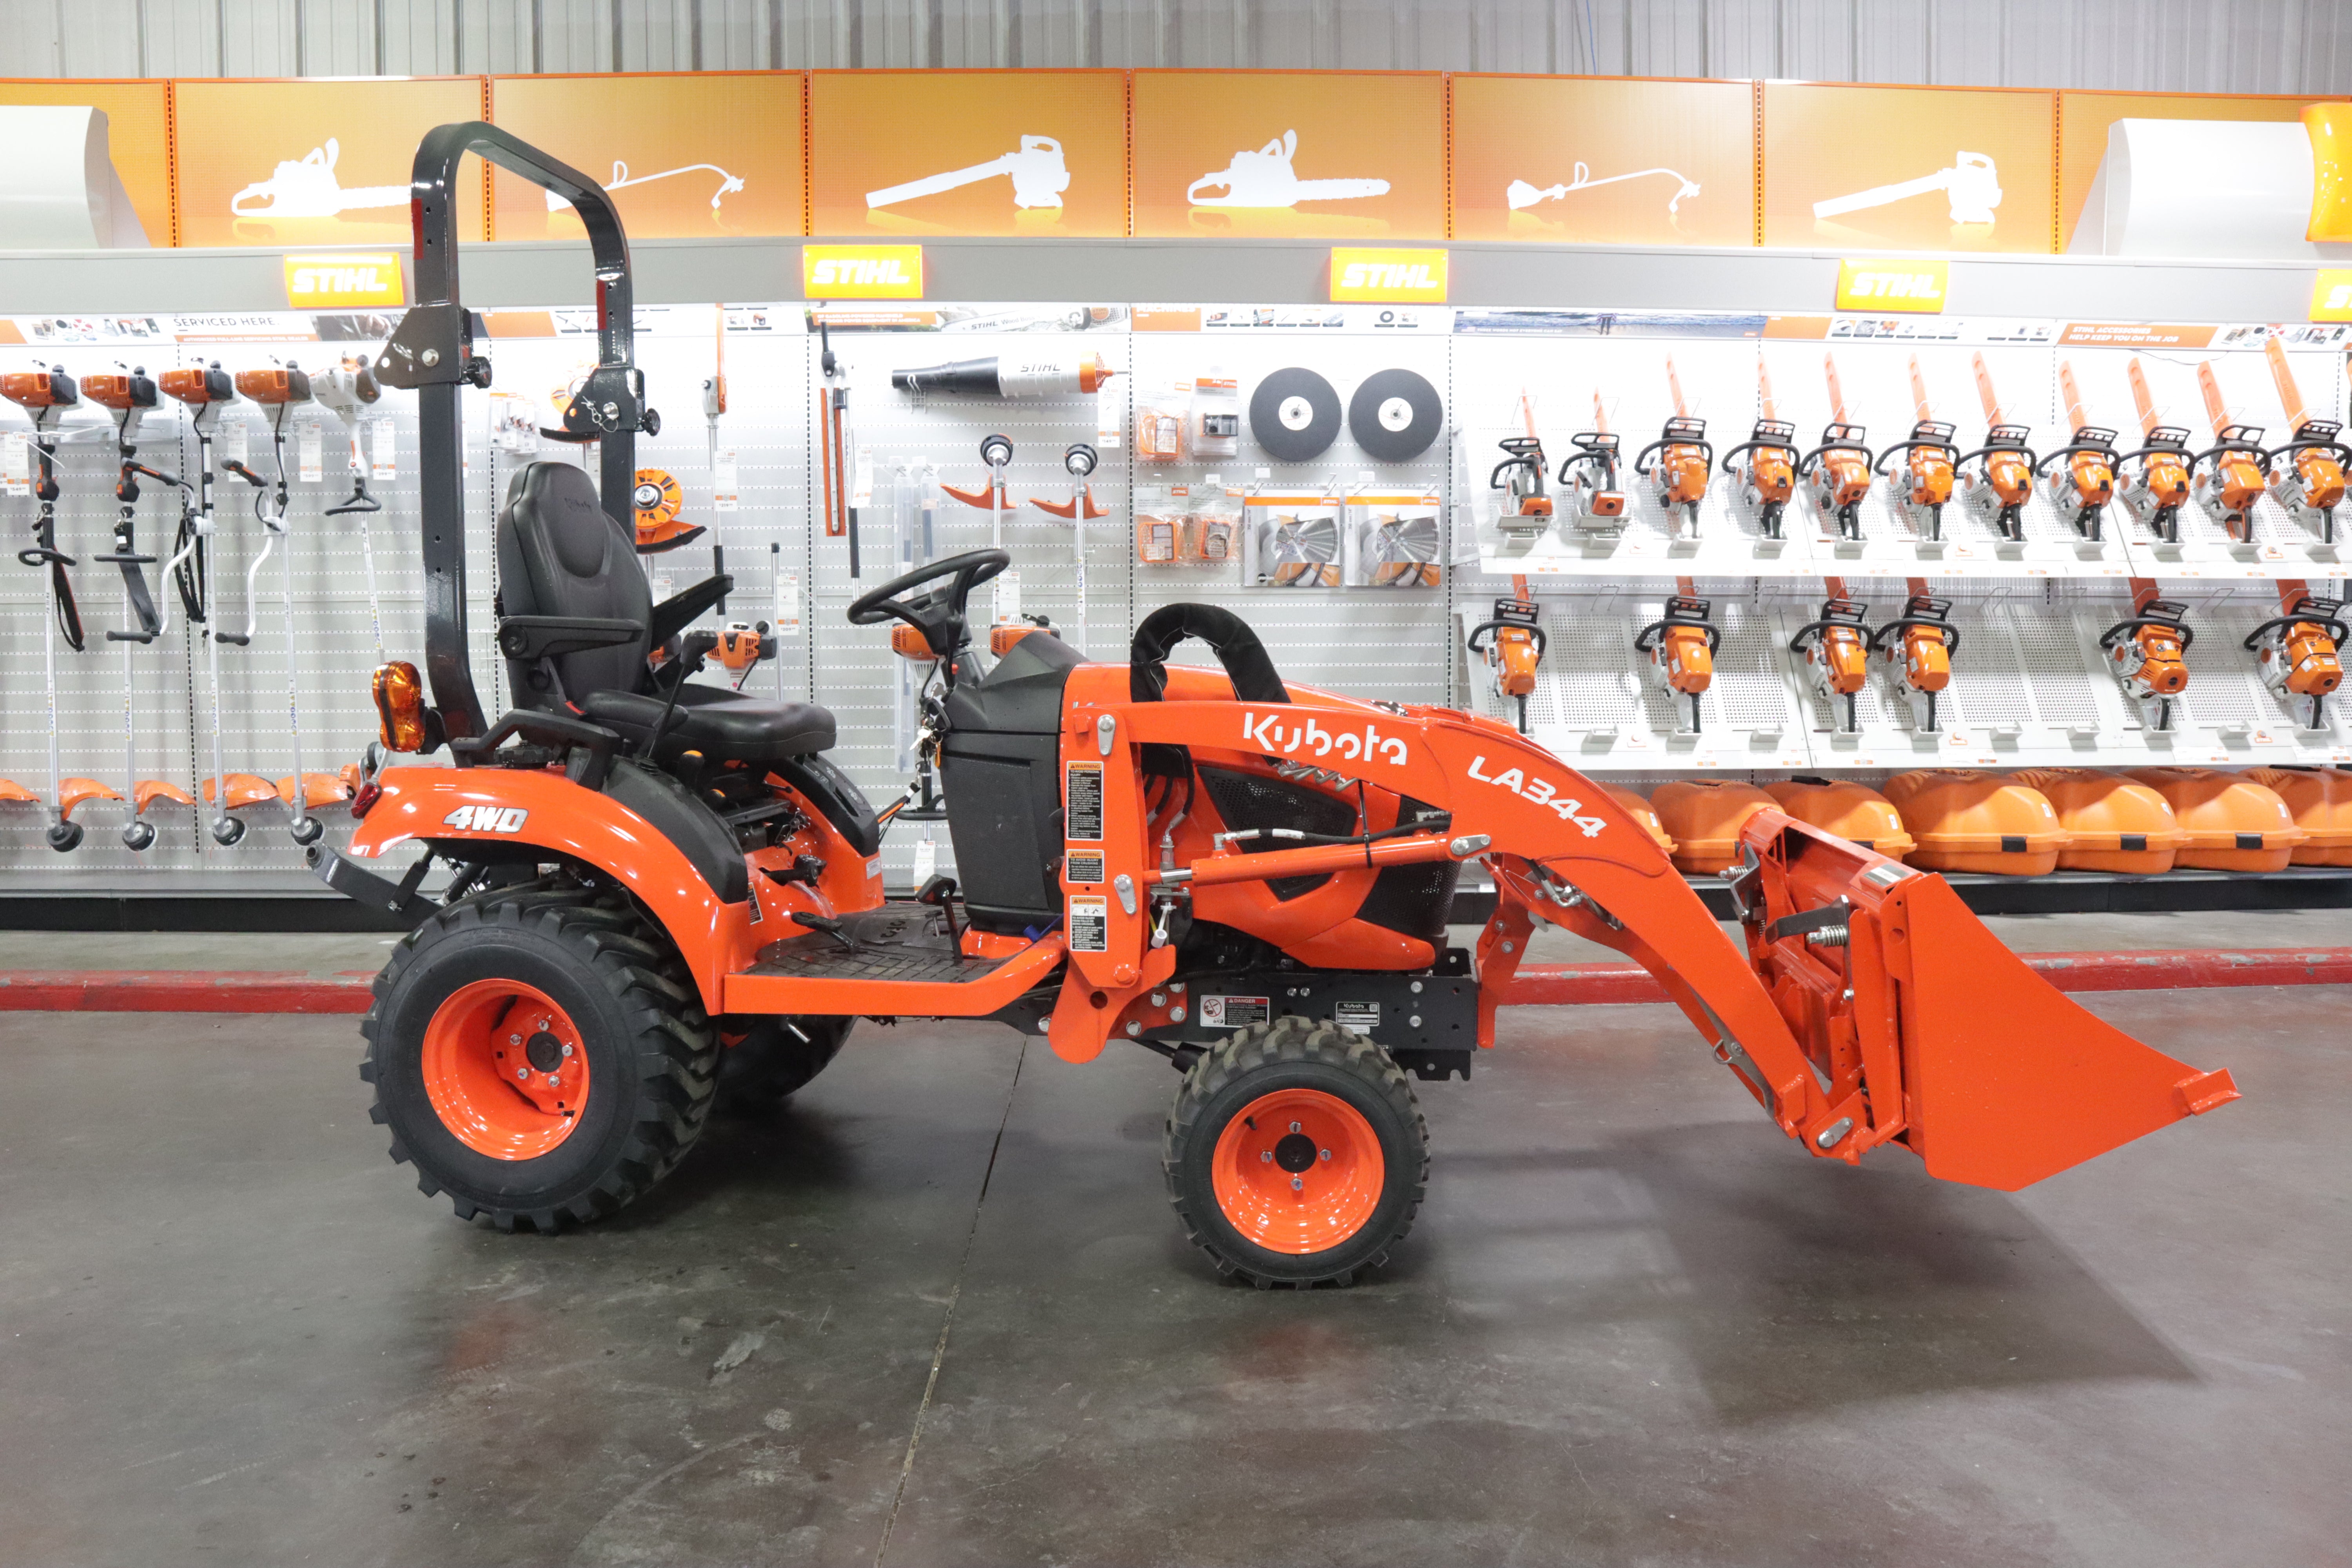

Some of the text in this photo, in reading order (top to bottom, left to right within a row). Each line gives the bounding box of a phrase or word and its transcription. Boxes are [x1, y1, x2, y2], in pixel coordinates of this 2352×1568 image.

[293, 268, 387, 292] STIHL
[812, 260, 909, 284] STIHL
[1341, 263, 1438, 288] STIHL
[1850, 272, 1941, 298] STIHL
[173, 317, 280, 326] SERVICED HERE.
[971, 321, 998, 330] STIHL
[1020, 363, 1061, 372] STIHL
[1243, 712, 1407, 765] Kubota
[1468, 755, 1607, 838] LA344
[442, 805, 529, 833] 4WD
